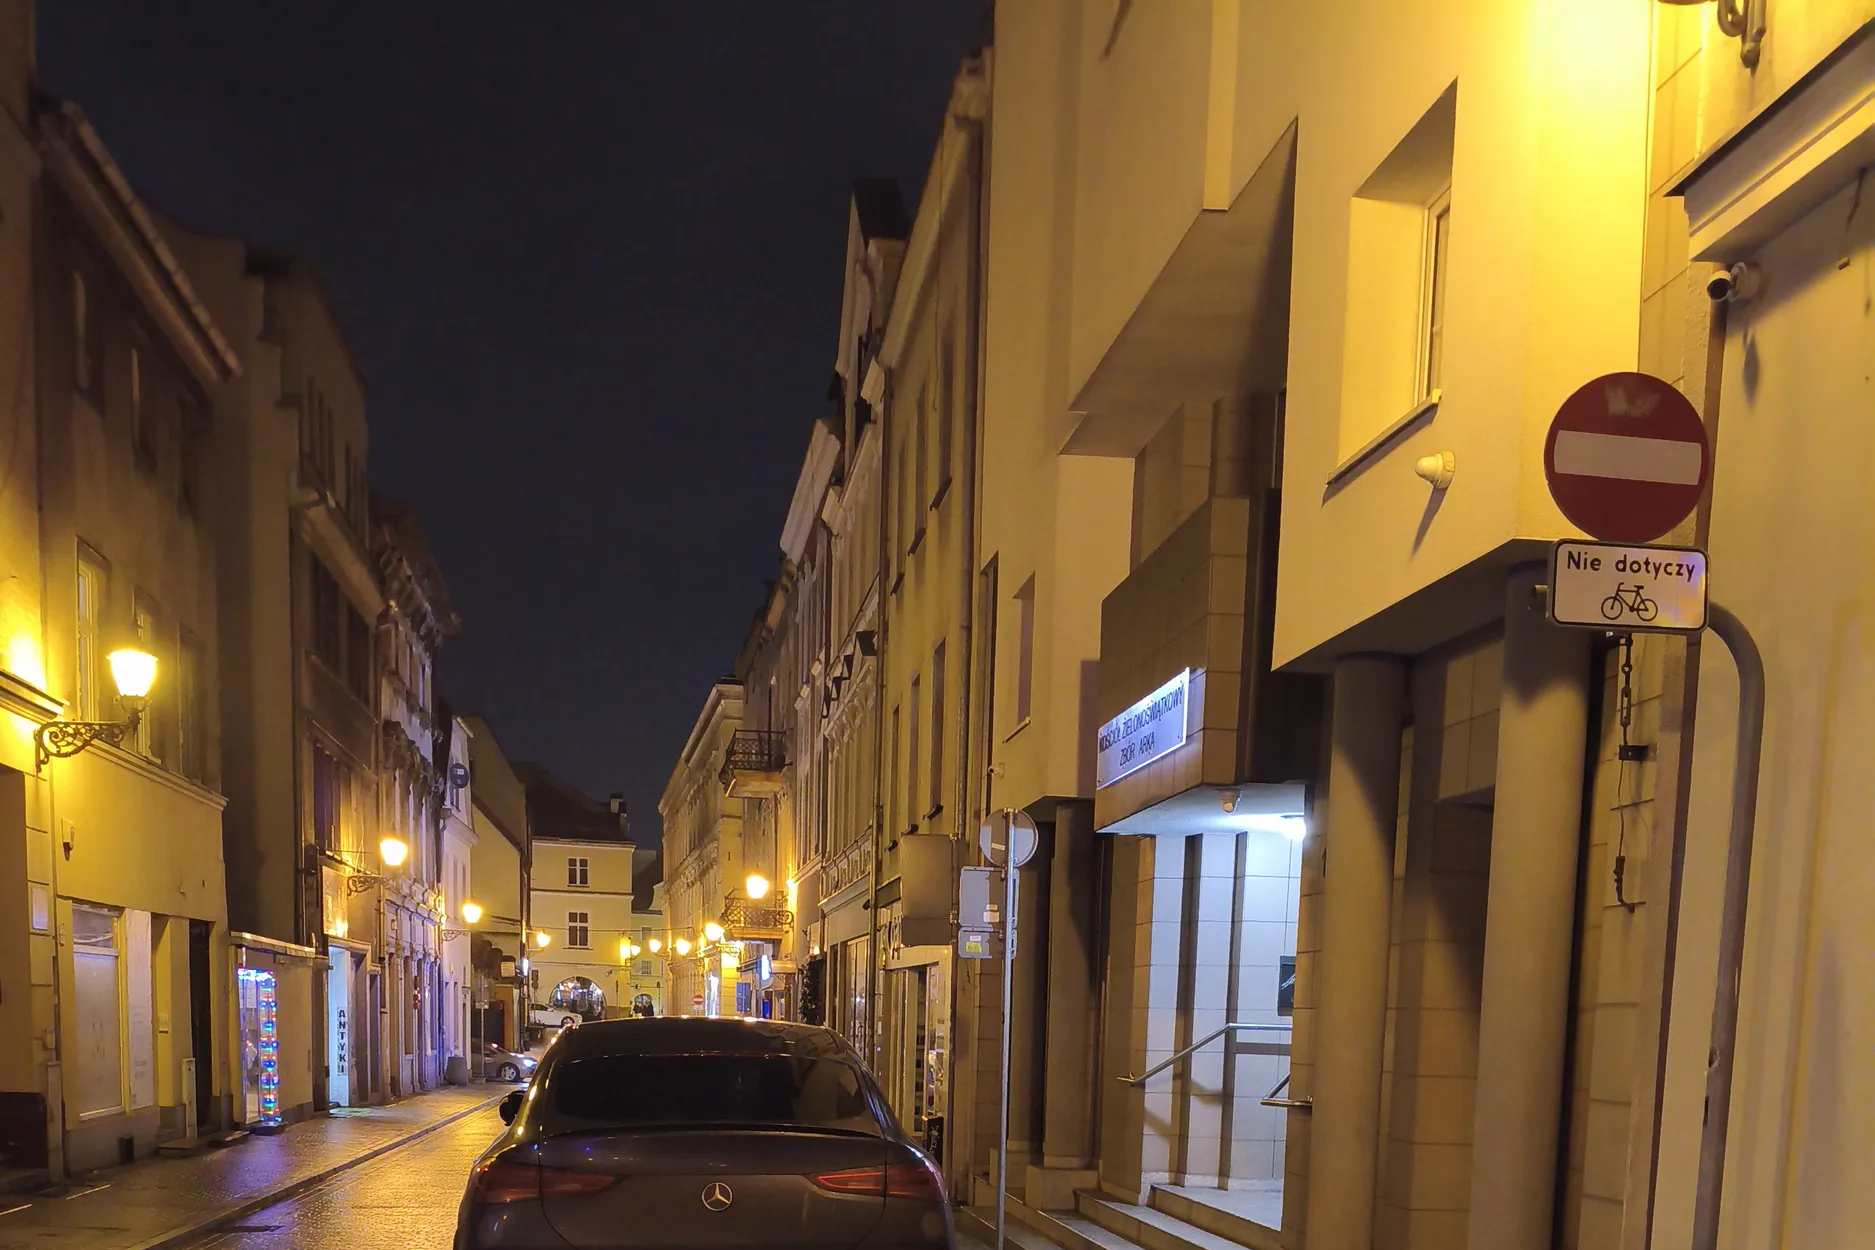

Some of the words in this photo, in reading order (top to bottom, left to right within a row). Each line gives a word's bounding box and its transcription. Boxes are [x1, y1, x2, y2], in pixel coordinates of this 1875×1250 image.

[1567, 551, 1602, 571] Nie
[1615, 553, 1696, 582] dotyczy
[1120, 741, 1136, 767] ZBÓR
[1138, 730, 1156, 756] ARKA
[338, 1009, 347, 1074] ANTYKI
